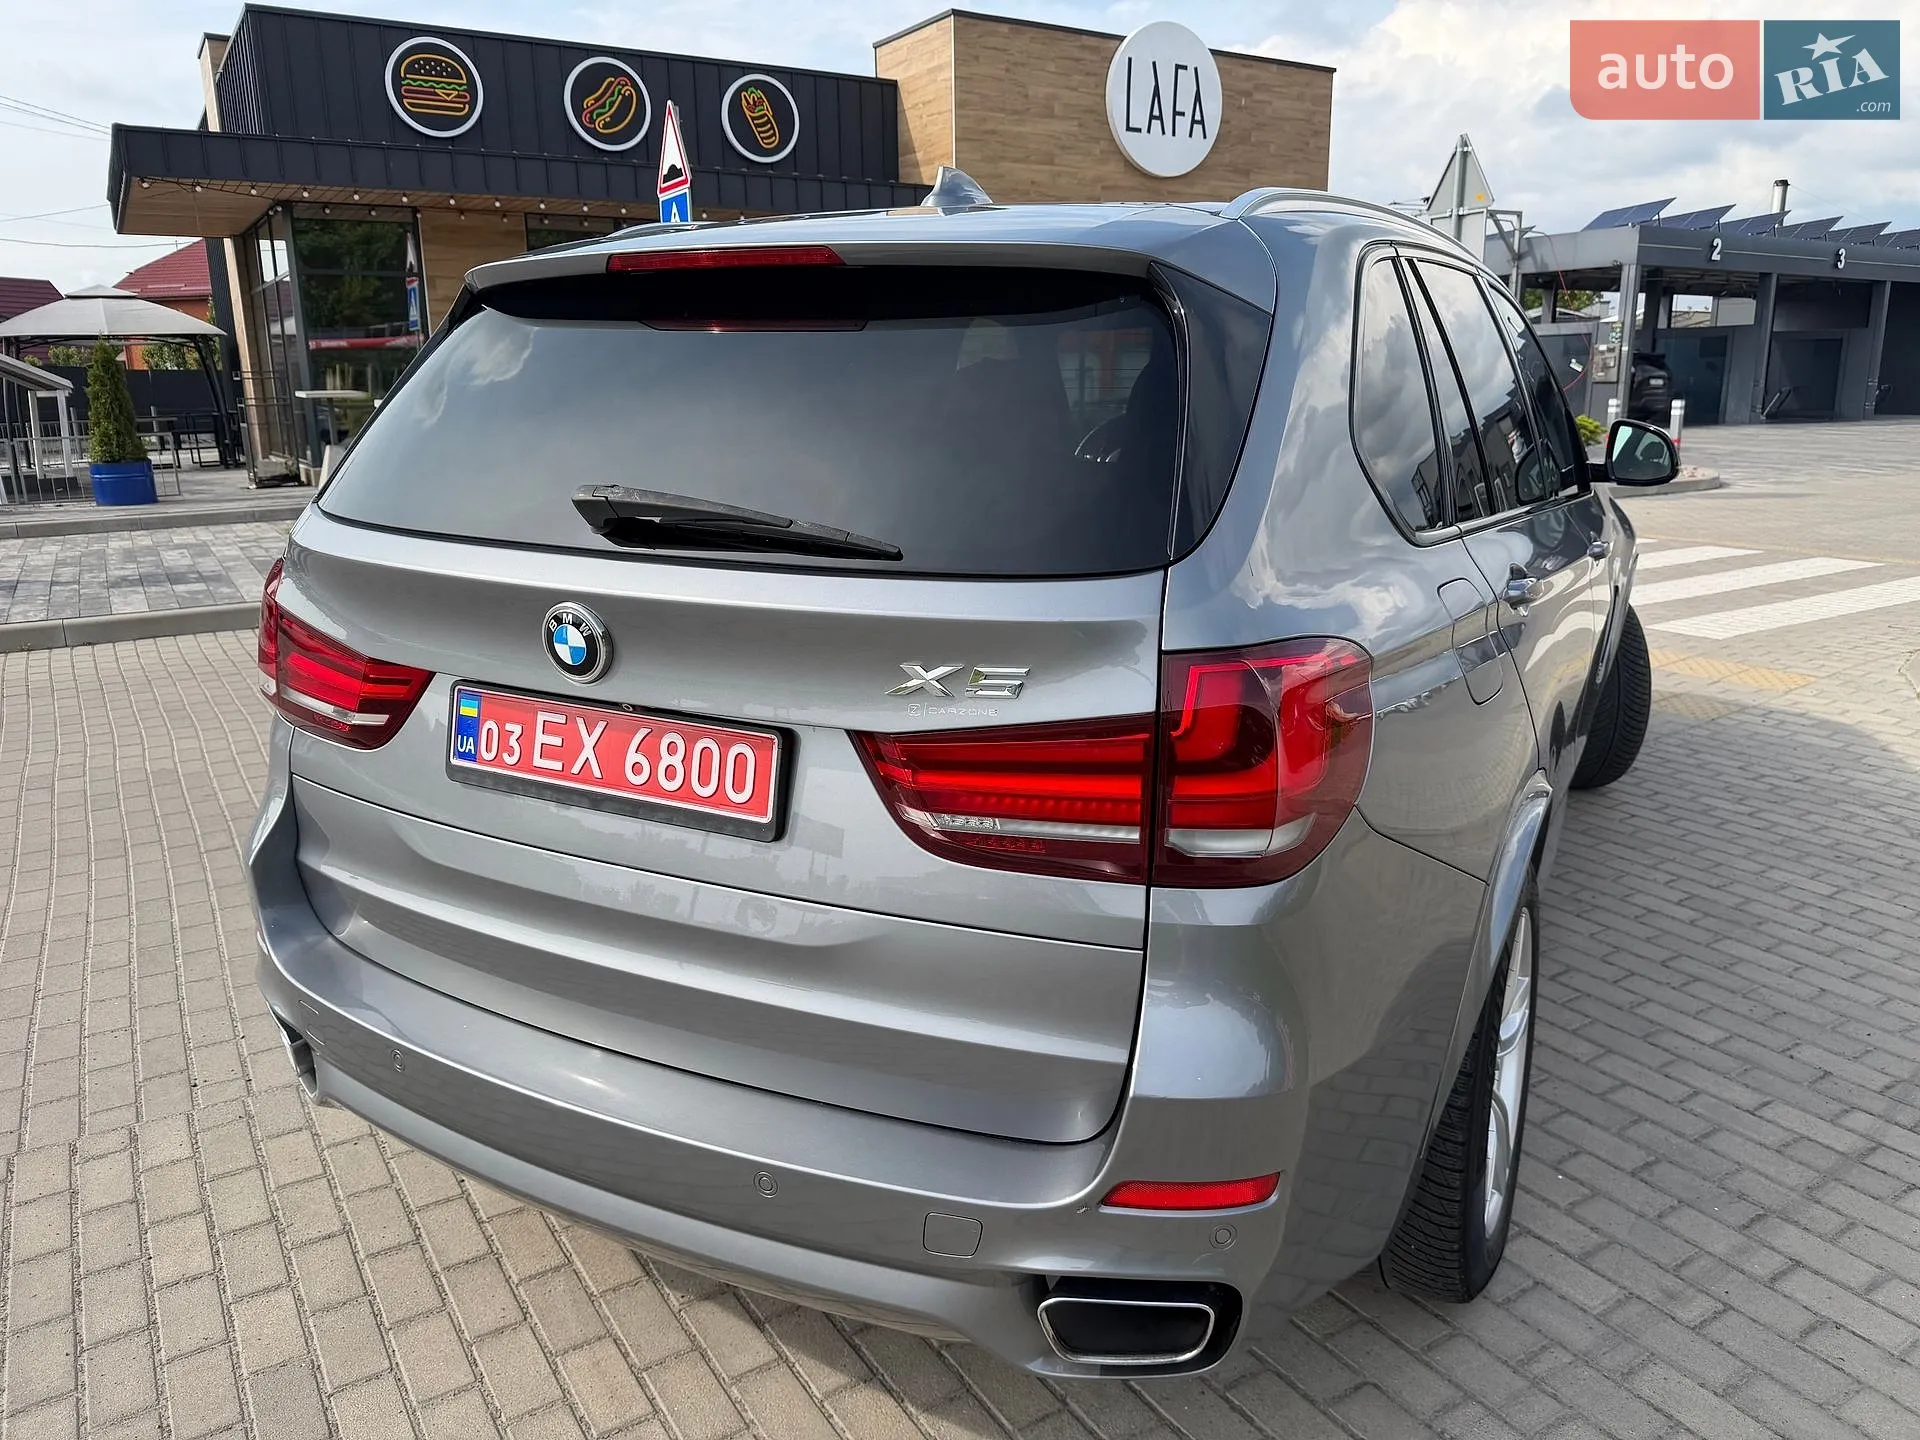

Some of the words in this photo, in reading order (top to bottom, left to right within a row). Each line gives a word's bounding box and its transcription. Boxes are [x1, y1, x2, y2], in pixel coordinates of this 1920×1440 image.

[1125, 56, 1207, 139] LAFA
[1711, 237, 1722, 261] 2
[1837, 248, 1846, 269] 3
[548, 612, 592, 637] BMW
[884, 663, 1031, 699] X5
[928, 705, 999, 717] CARZONE
[457, 734, 475, 755] UA
[624, 727, 756, 804] 6800
